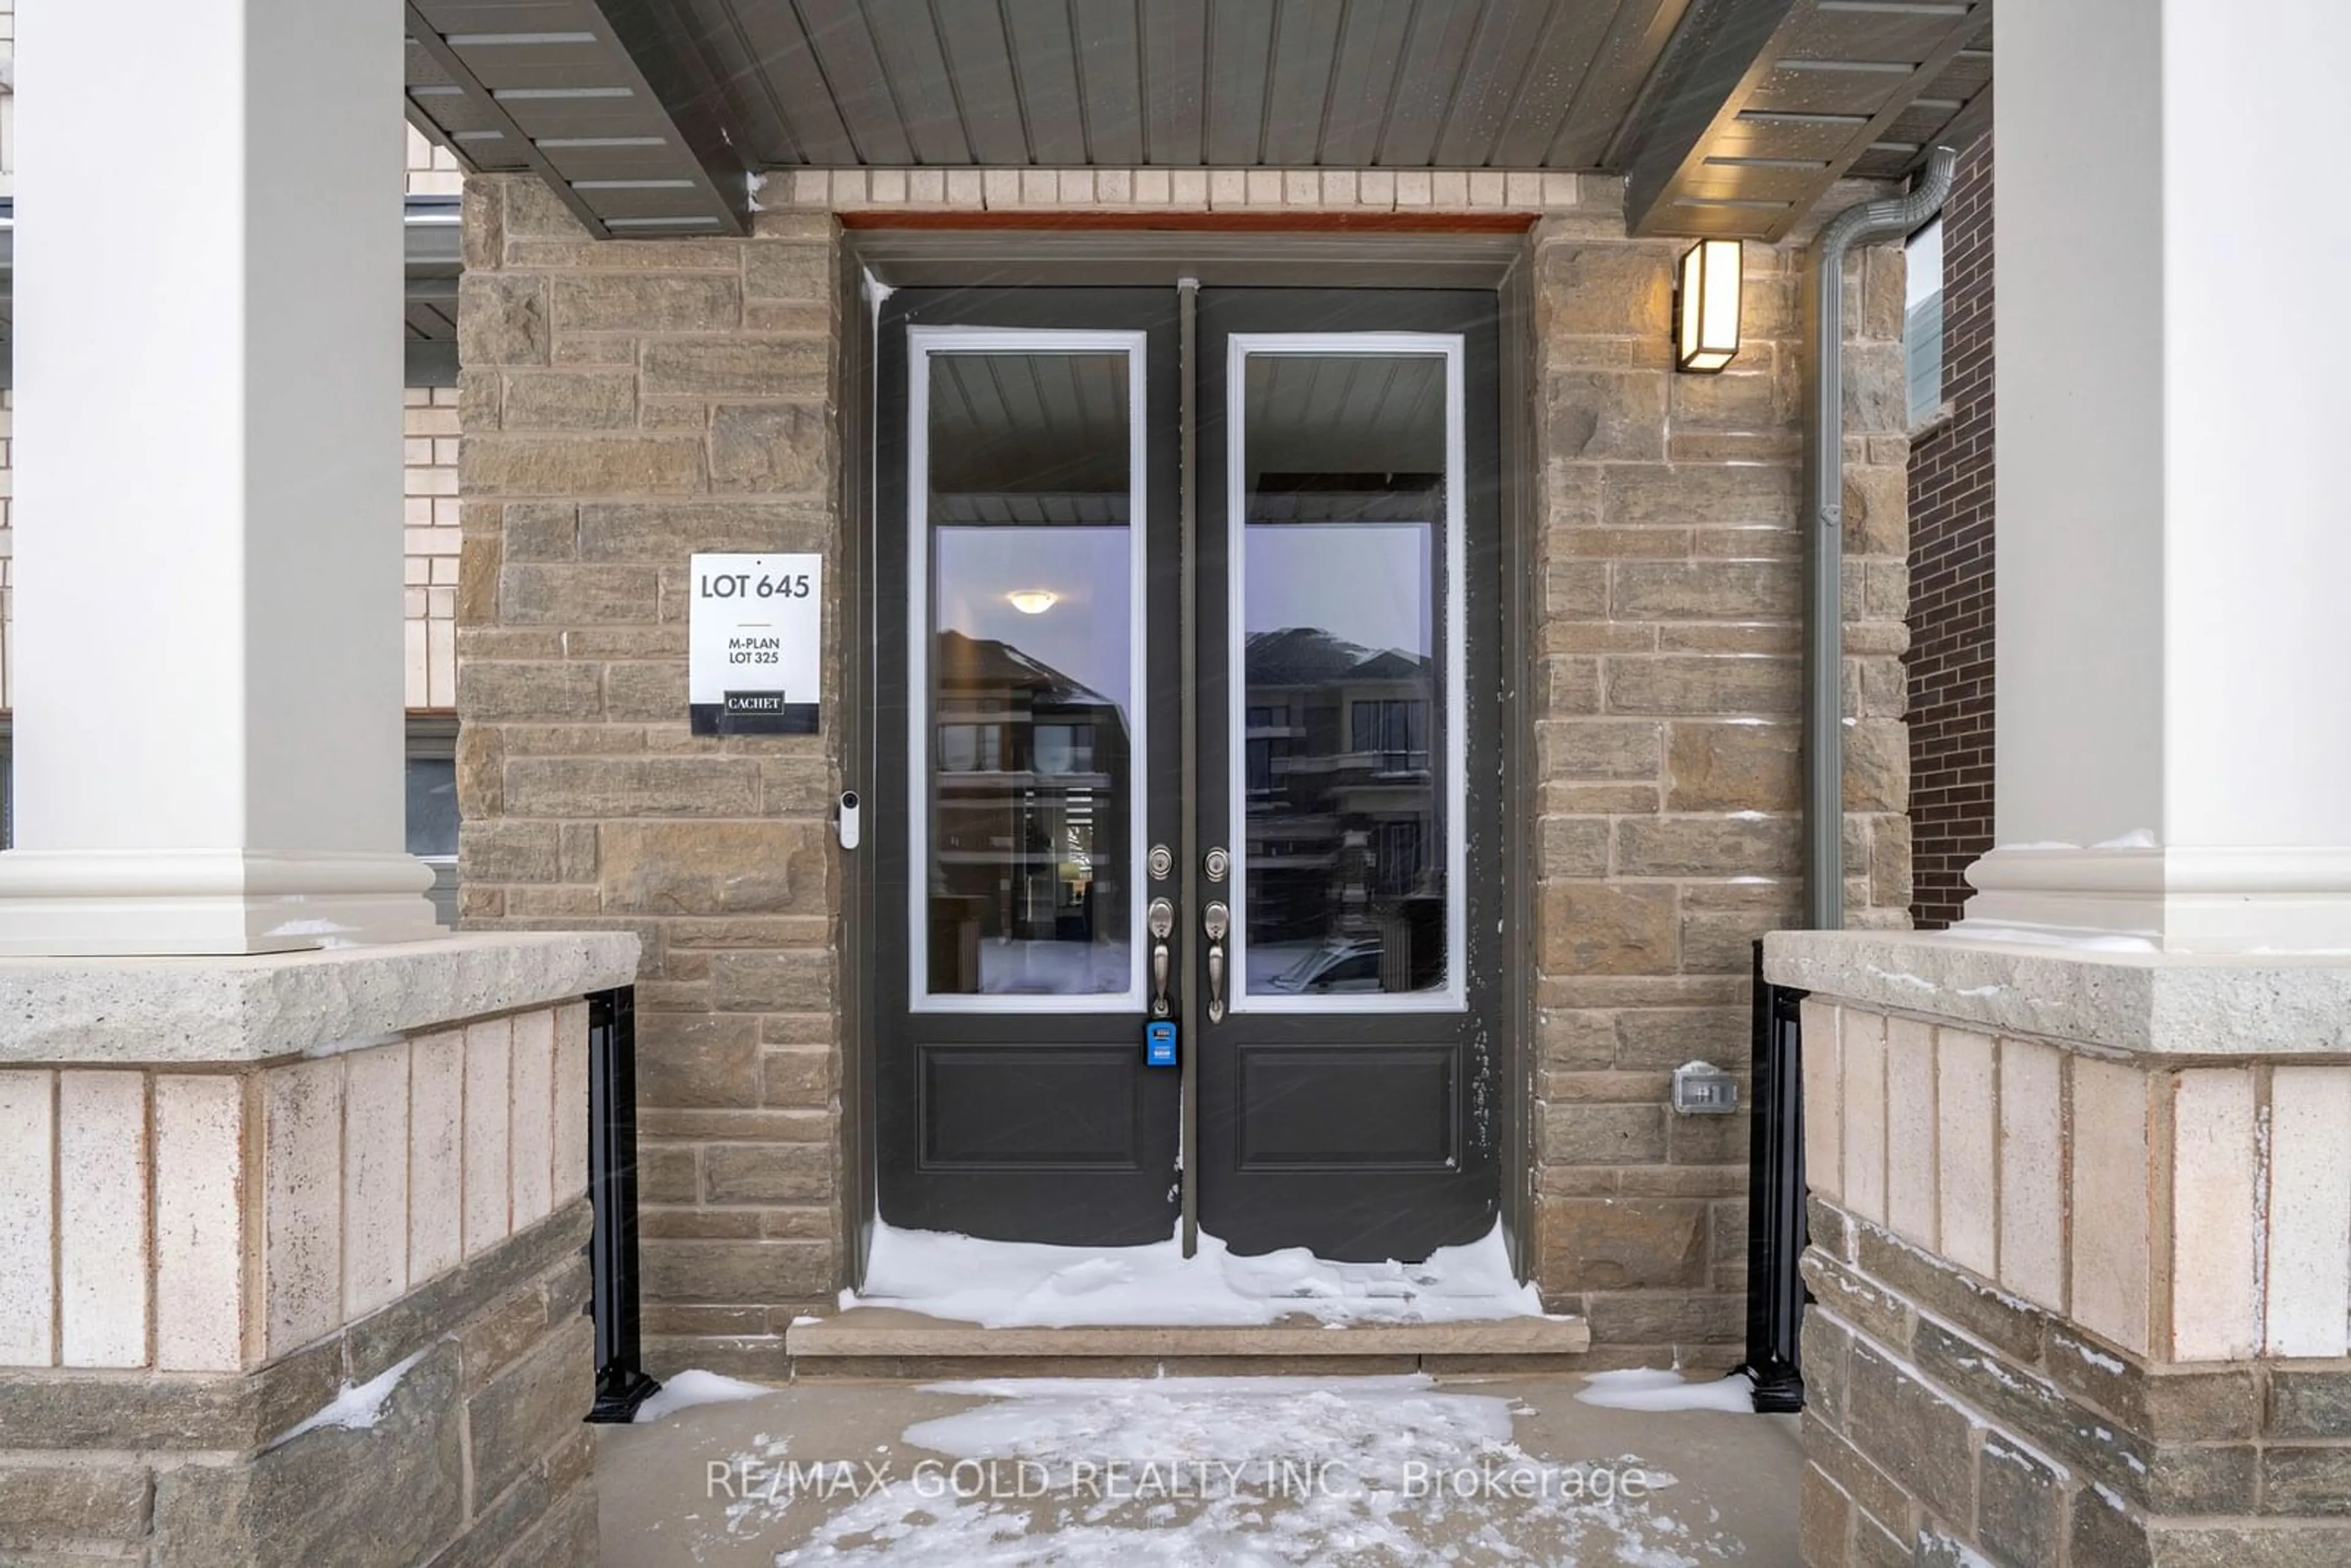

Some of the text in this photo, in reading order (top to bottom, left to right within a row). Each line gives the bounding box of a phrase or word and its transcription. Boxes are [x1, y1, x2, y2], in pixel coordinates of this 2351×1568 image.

[702, 574, 809, 598] LOT 645
[729, 638, 779, 649] M-PLAN
[730, 653, 778, 663] LOT 325
[729, 697, 781, 709] CACHET
